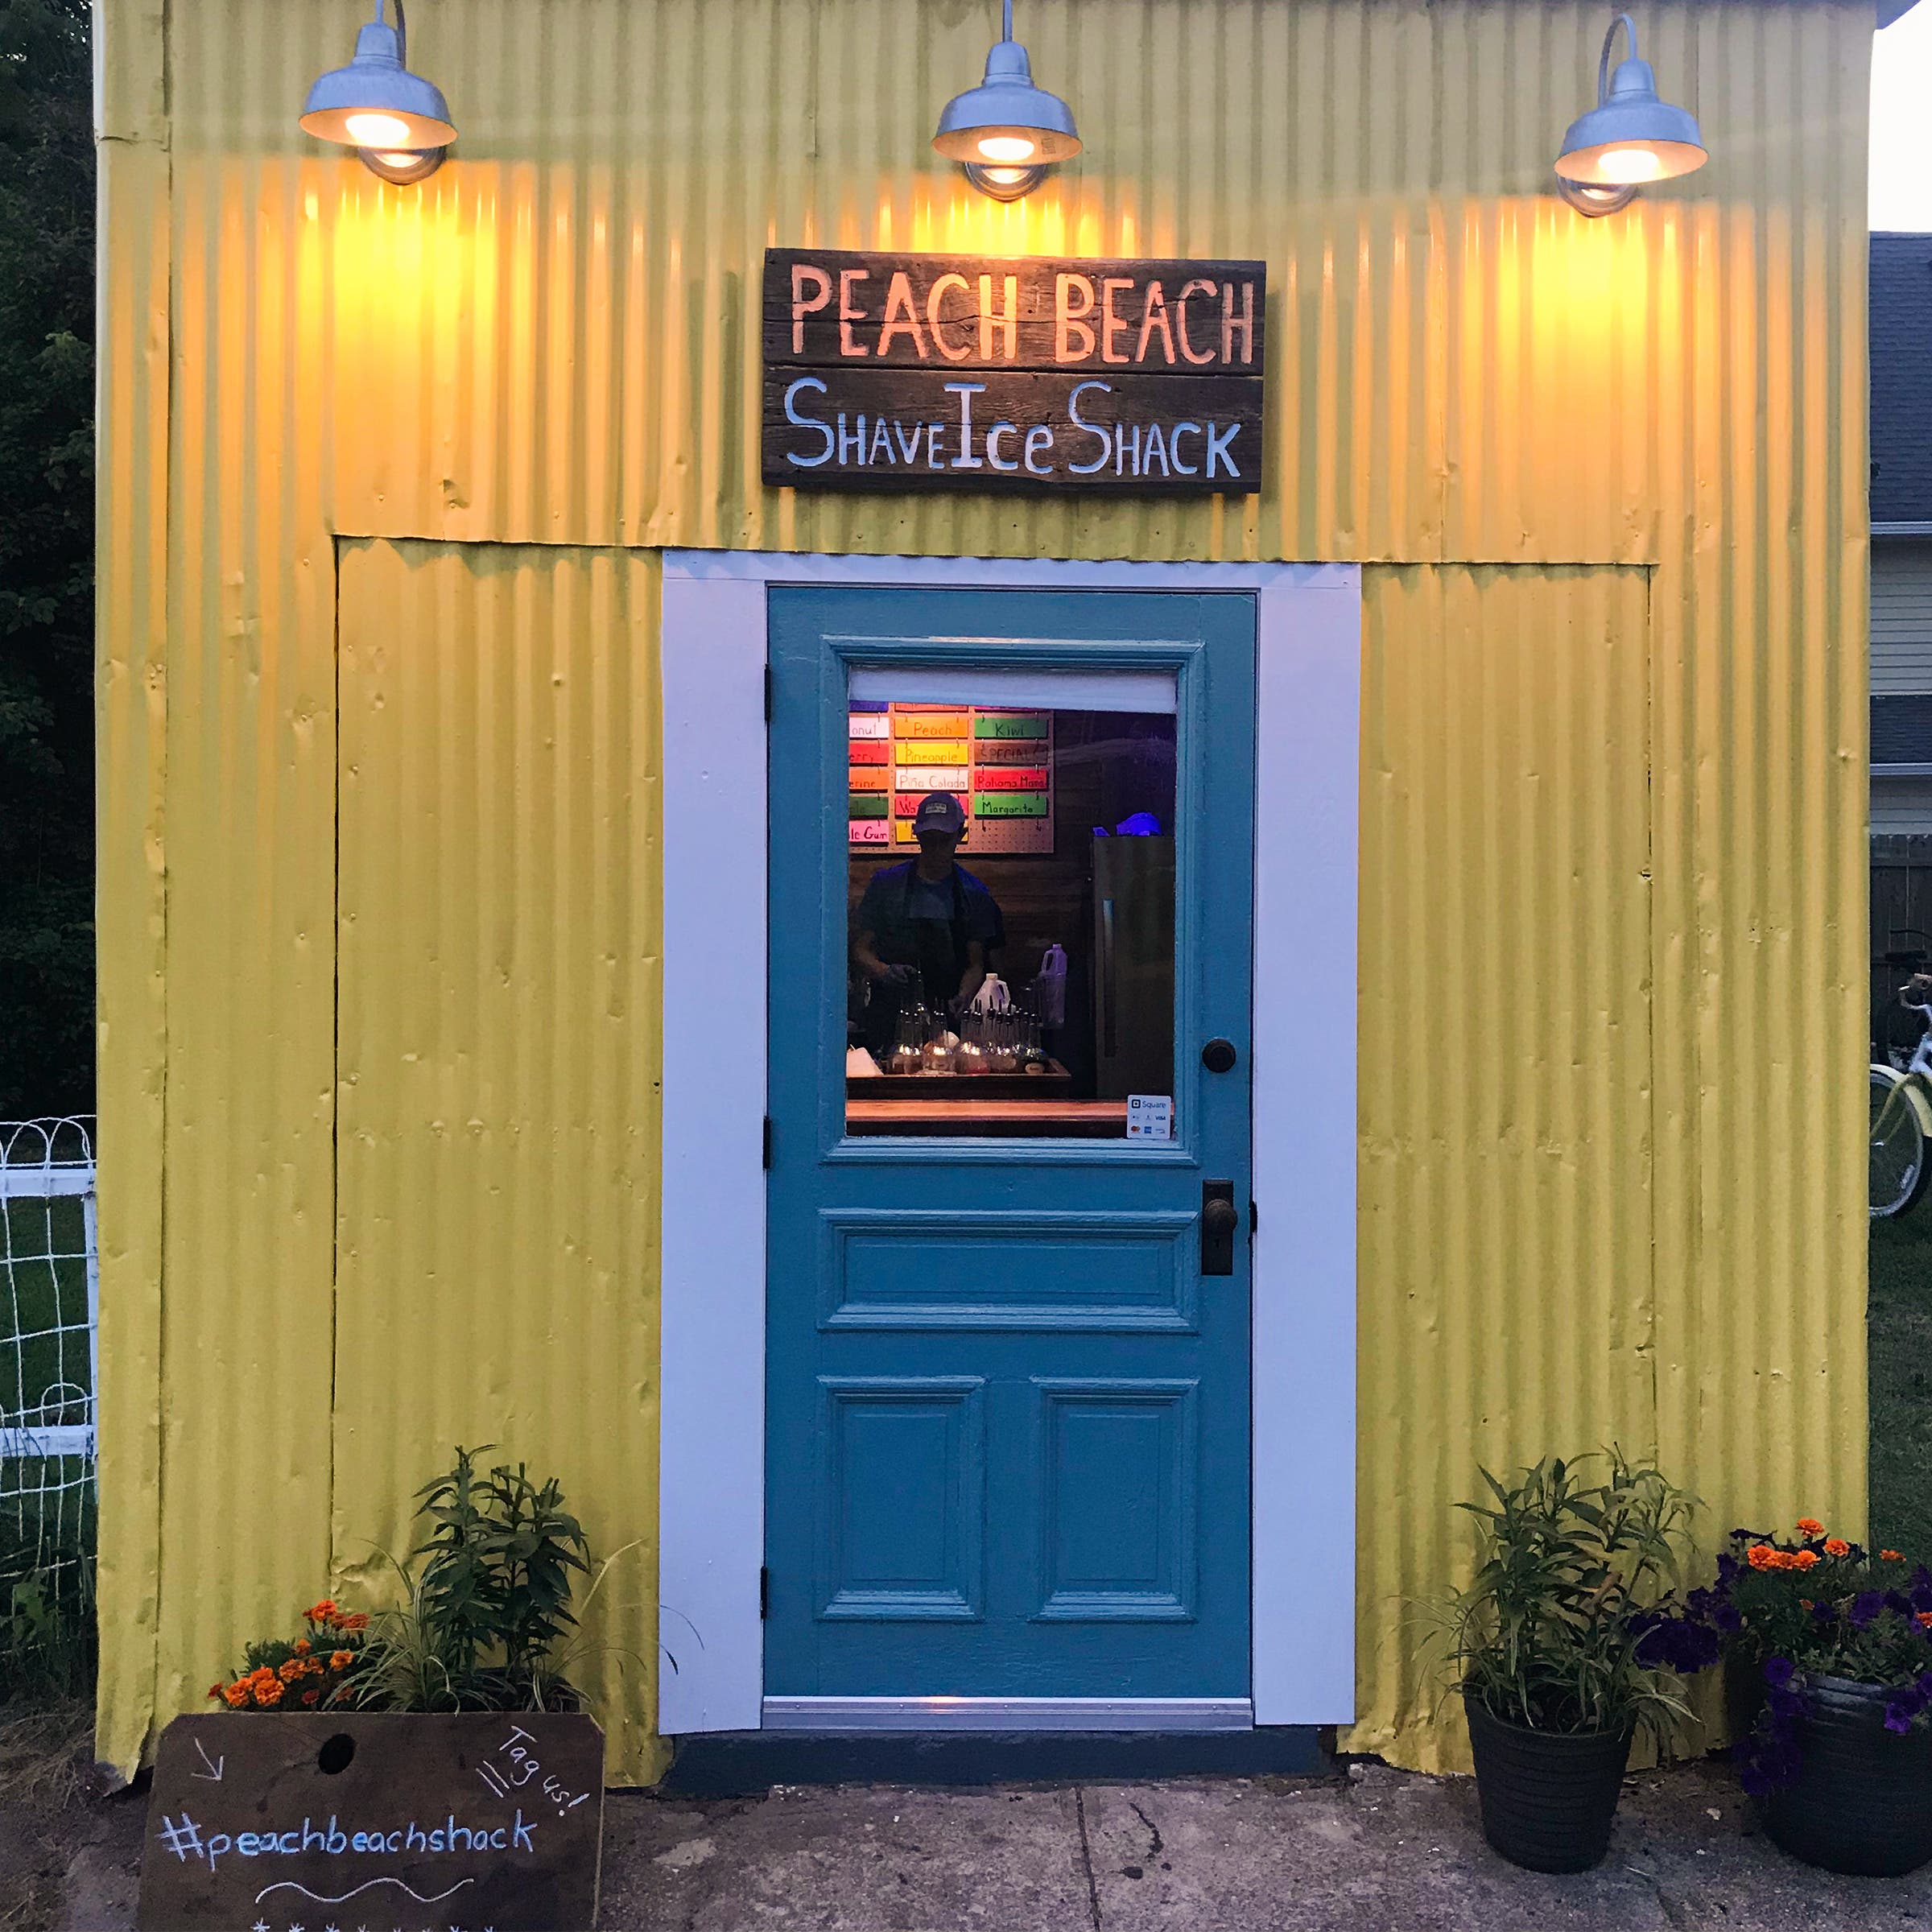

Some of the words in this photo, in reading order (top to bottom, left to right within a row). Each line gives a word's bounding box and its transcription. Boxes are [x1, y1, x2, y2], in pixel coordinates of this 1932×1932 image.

[791, 264, 1018, 361] PEACH
[1055, 273, 1254, 365] BEACH
[914, 721, 952, 737] Peach
[995, 723, 1024, 737] Kiwi
[905, 749, 958, 764] Pineapple
[929, 775, 965, 788] Colada
[982, 802, 1034, 814] Margarita
[1141, 1100, 1166, 1108] Square
[499, 1725, 540, 1785] Tag
[543, 1774, 590, 1817] us!
[155, 1809, 538, 1872] #peachbeachshack
